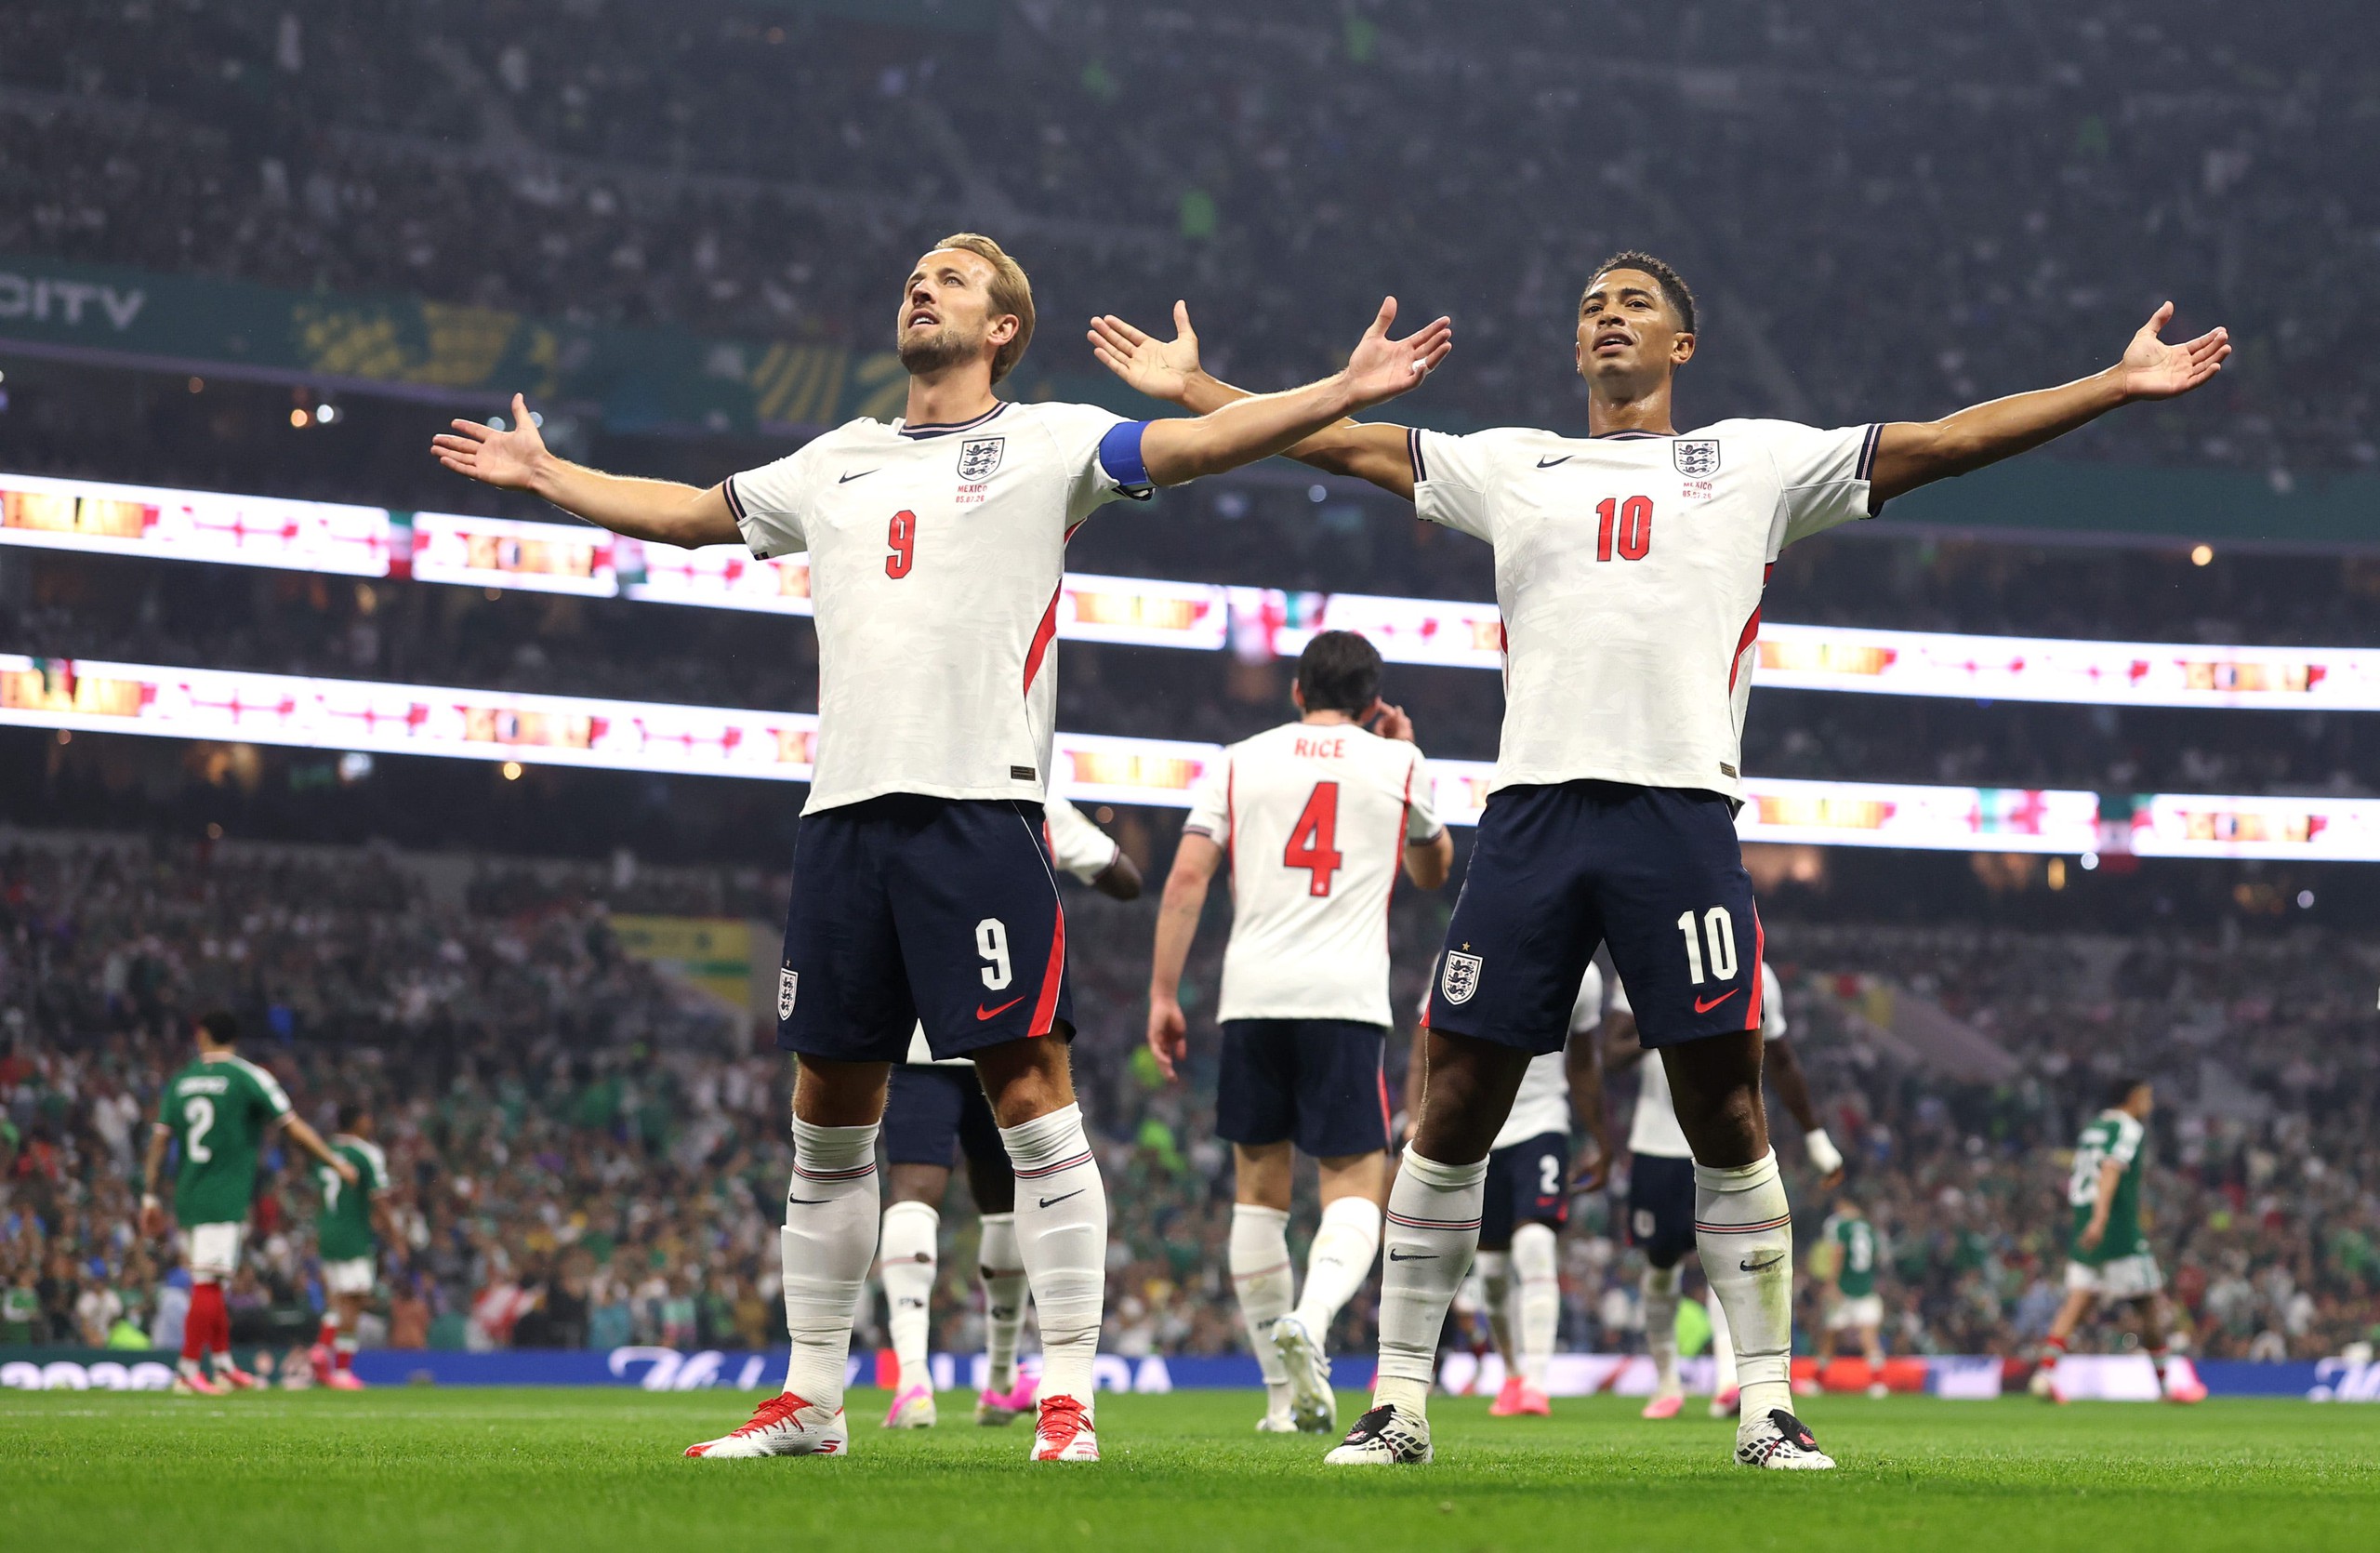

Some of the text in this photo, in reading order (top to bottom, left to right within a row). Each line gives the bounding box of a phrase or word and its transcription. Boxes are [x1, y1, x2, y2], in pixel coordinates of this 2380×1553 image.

[958, 484, 987, 493] MEXICO
[1684, 481, 1712, 490] MEXICO
[884, 509, 917, 580] 9
[1596, 495, 1654, 562] 10
[1294, 737, 1346, 758] RICE
[1284, 781, 1343, 897] 4
[975, 917, 1012, 991] 9
[1677, 906, 1739, 985] 10
[185, 1095, 214, 1163] 2
[1539, 1154, 1560, 1194] 2
